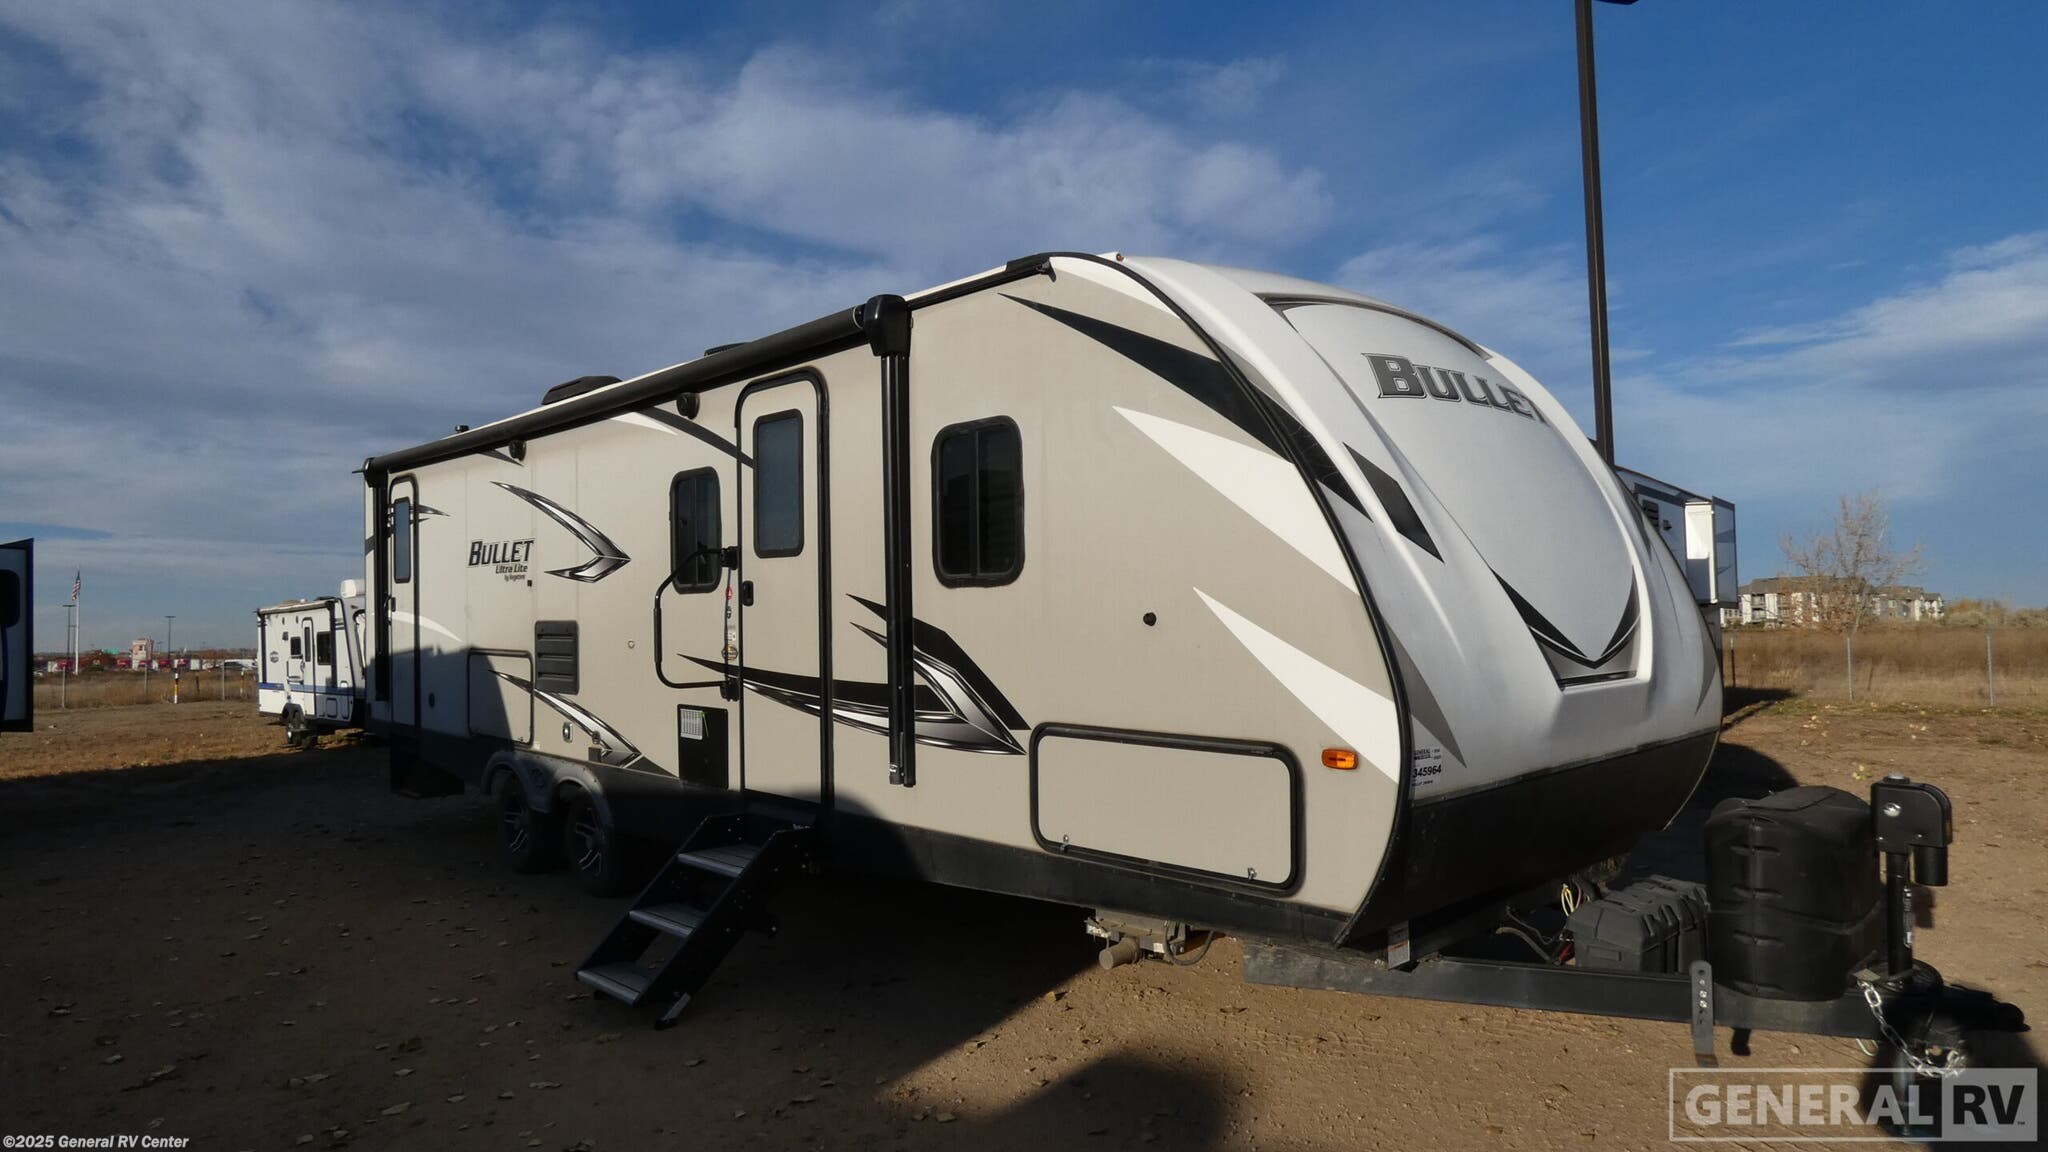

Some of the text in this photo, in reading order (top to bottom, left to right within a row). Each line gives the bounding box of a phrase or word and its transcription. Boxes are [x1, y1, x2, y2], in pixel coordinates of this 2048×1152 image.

[468, 539, 535, 567] BULLET
[495, 563, 528, 574] Ultra Lite
[1412, 764, 1442, 778] 345964
